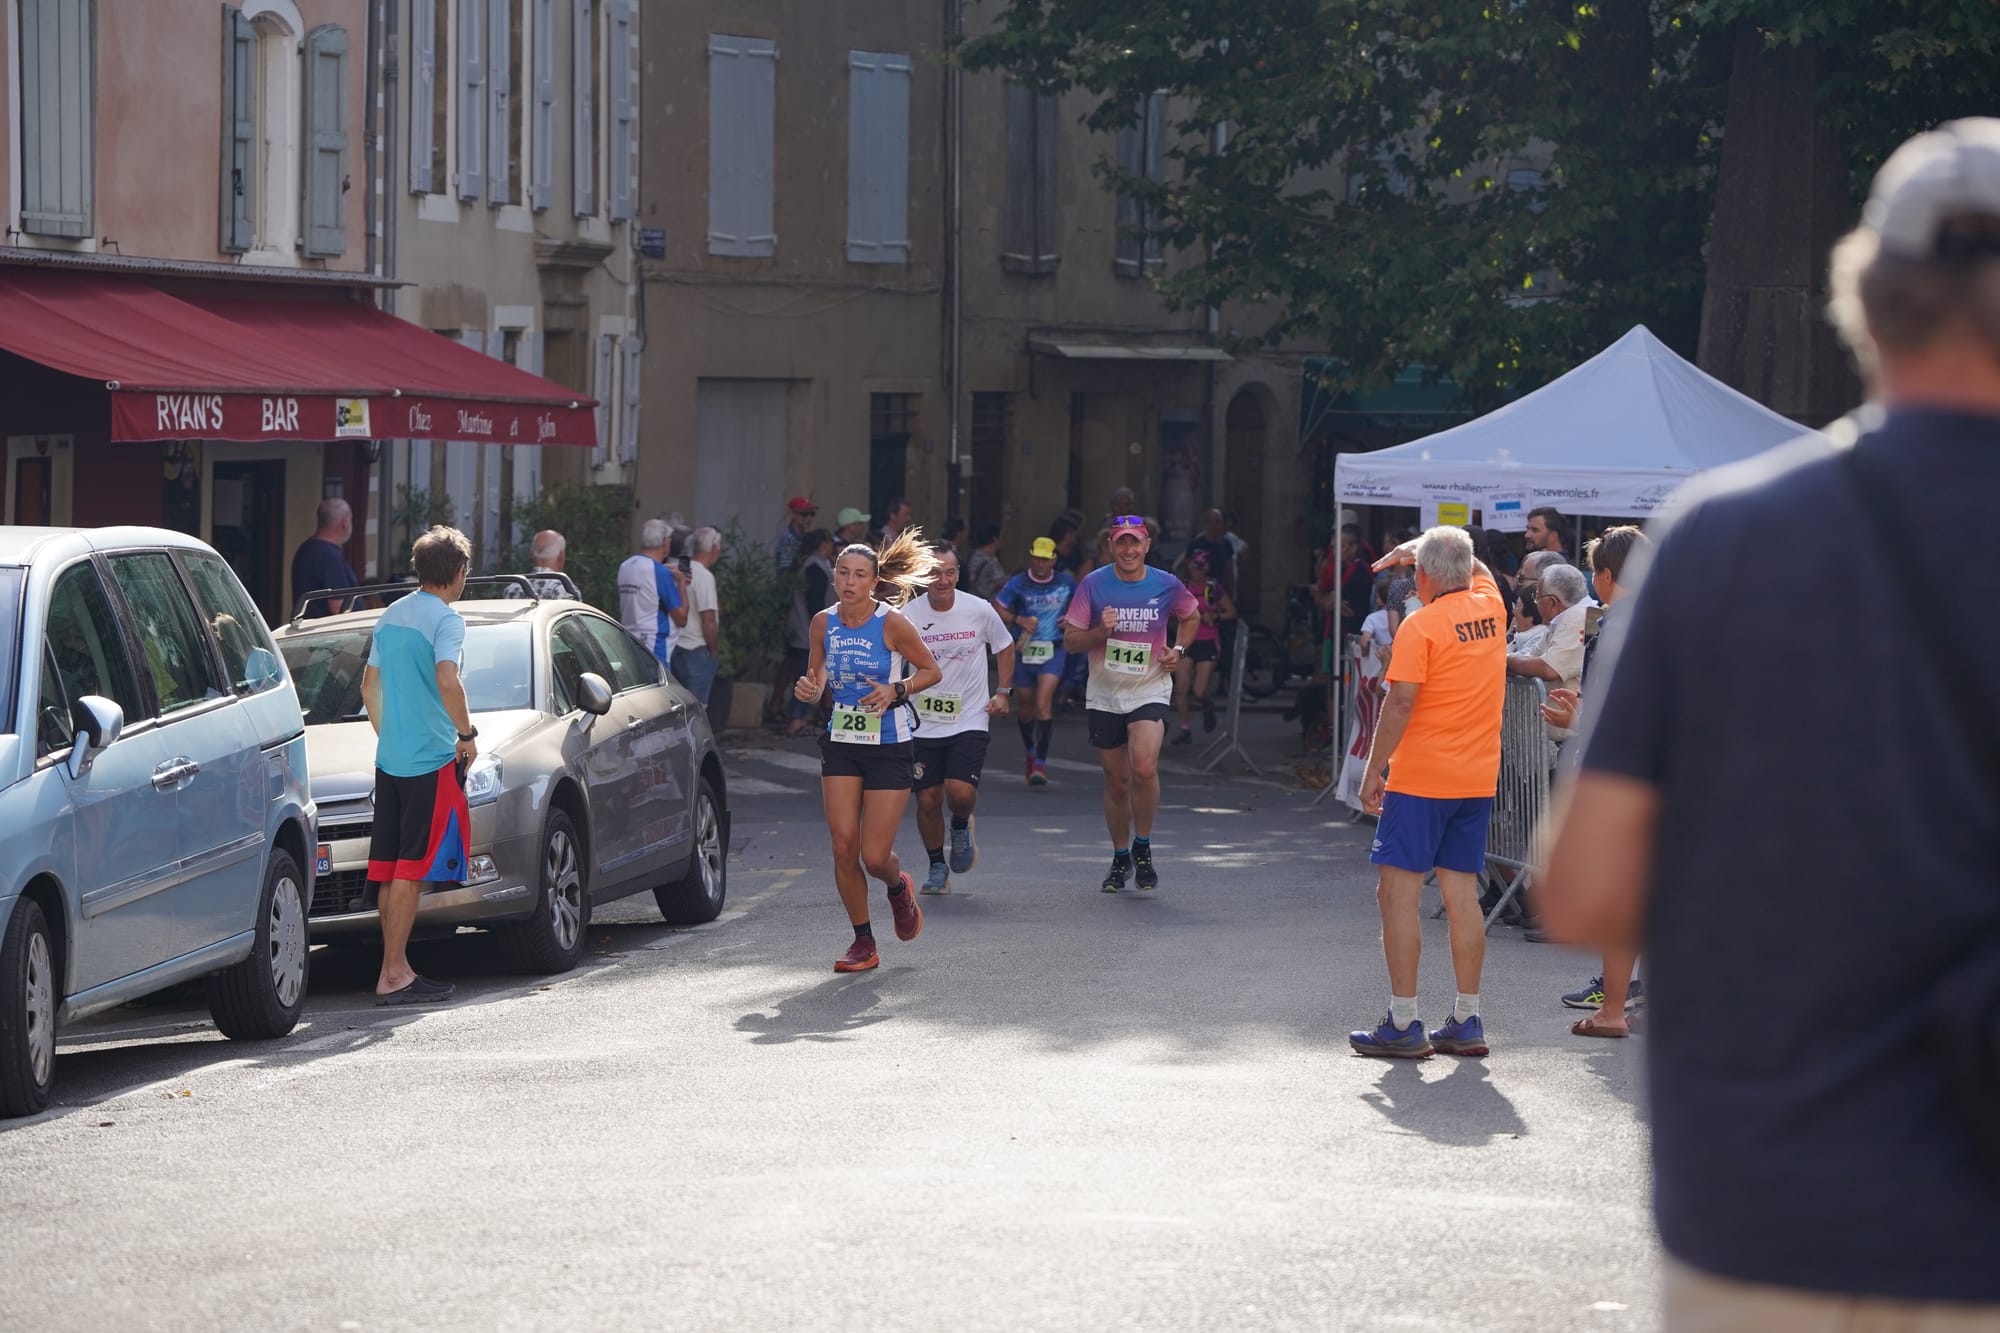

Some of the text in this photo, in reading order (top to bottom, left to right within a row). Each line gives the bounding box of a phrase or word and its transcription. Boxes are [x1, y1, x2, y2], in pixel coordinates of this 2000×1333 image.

[156, 395, 299, 431] RYAN'S BAR
[409, 403, 432, 432] Chez
[458, 409, 493, 435] Martine
[1115, 607, 1159, 621] ARVEJOLS
[1114, 621, 1149, 632] MENDE
[1455, 617, 1496, 642] STAFF
[1030, 646, 1046, 656] 75
[1112, 648, 1144, 664] 114
[923, 697, 955, 713] 183
[842, 714, 866, 731] 28
